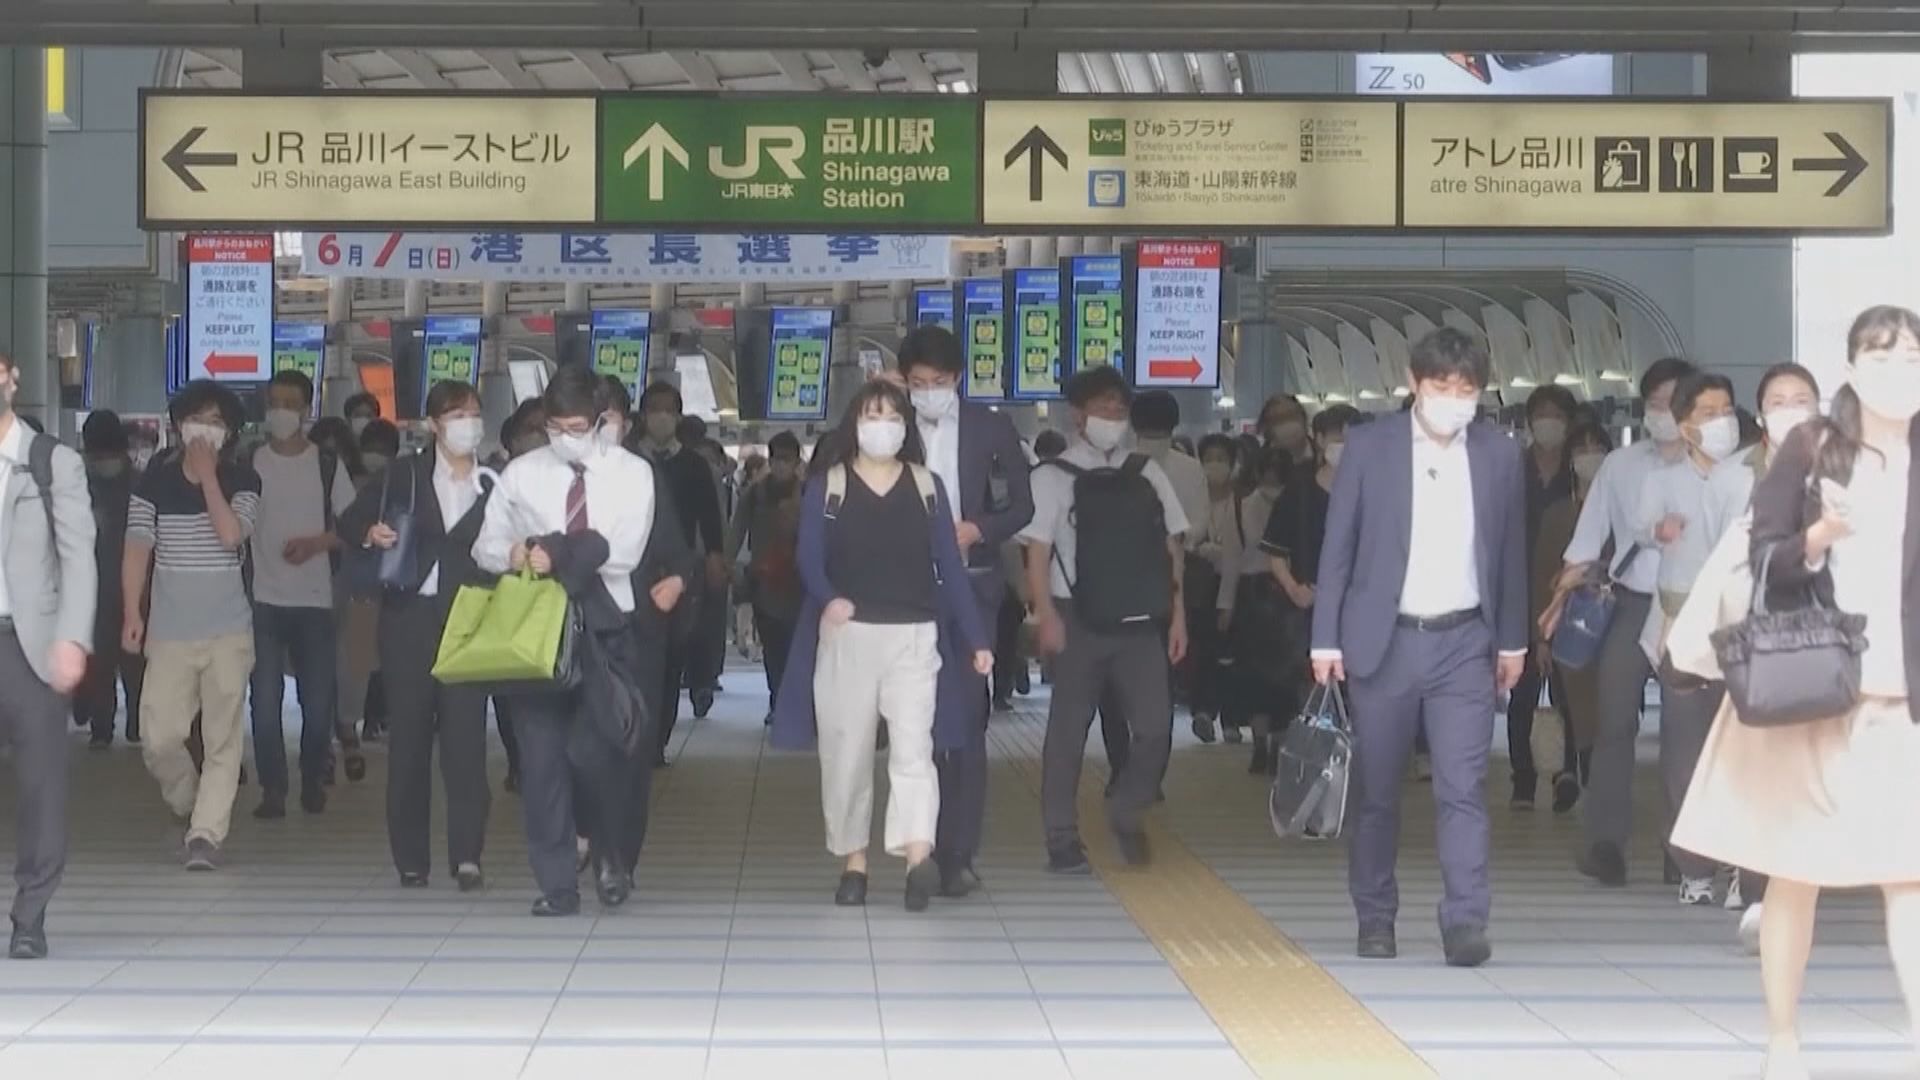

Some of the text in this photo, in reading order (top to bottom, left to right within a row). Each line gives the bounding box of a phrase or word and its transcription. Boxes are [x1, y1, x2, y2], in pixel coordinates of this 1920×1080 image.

[1403, 74, 1424, 89] 50
[823, 117, 936, 155] 品川駅
[1134, 119, 1234, 137] びゅうプラザ
[251, 131, 570, 165] JR 品川イーストビル
[708, 126, 807, 179] JR
[1430, 136, 1583, 168] アトレ品川
[251, 170, 526, 193] JR Shinagawa East Building
[823, 161, 950, 185] Shinagawa
[721, 183, 795, 199] JR東日本
[1430, 176, 1582, 197] atre Shinagawa
[823, 188, 905, 208] Station
[214, 251, 247, 260] NOTICE
[1163, 257, 1195, 266] NOTICE
[205, 324, 255, 335] KEEP LEFT
[1150, 330, 1205, 340] KEEP RIGHT
